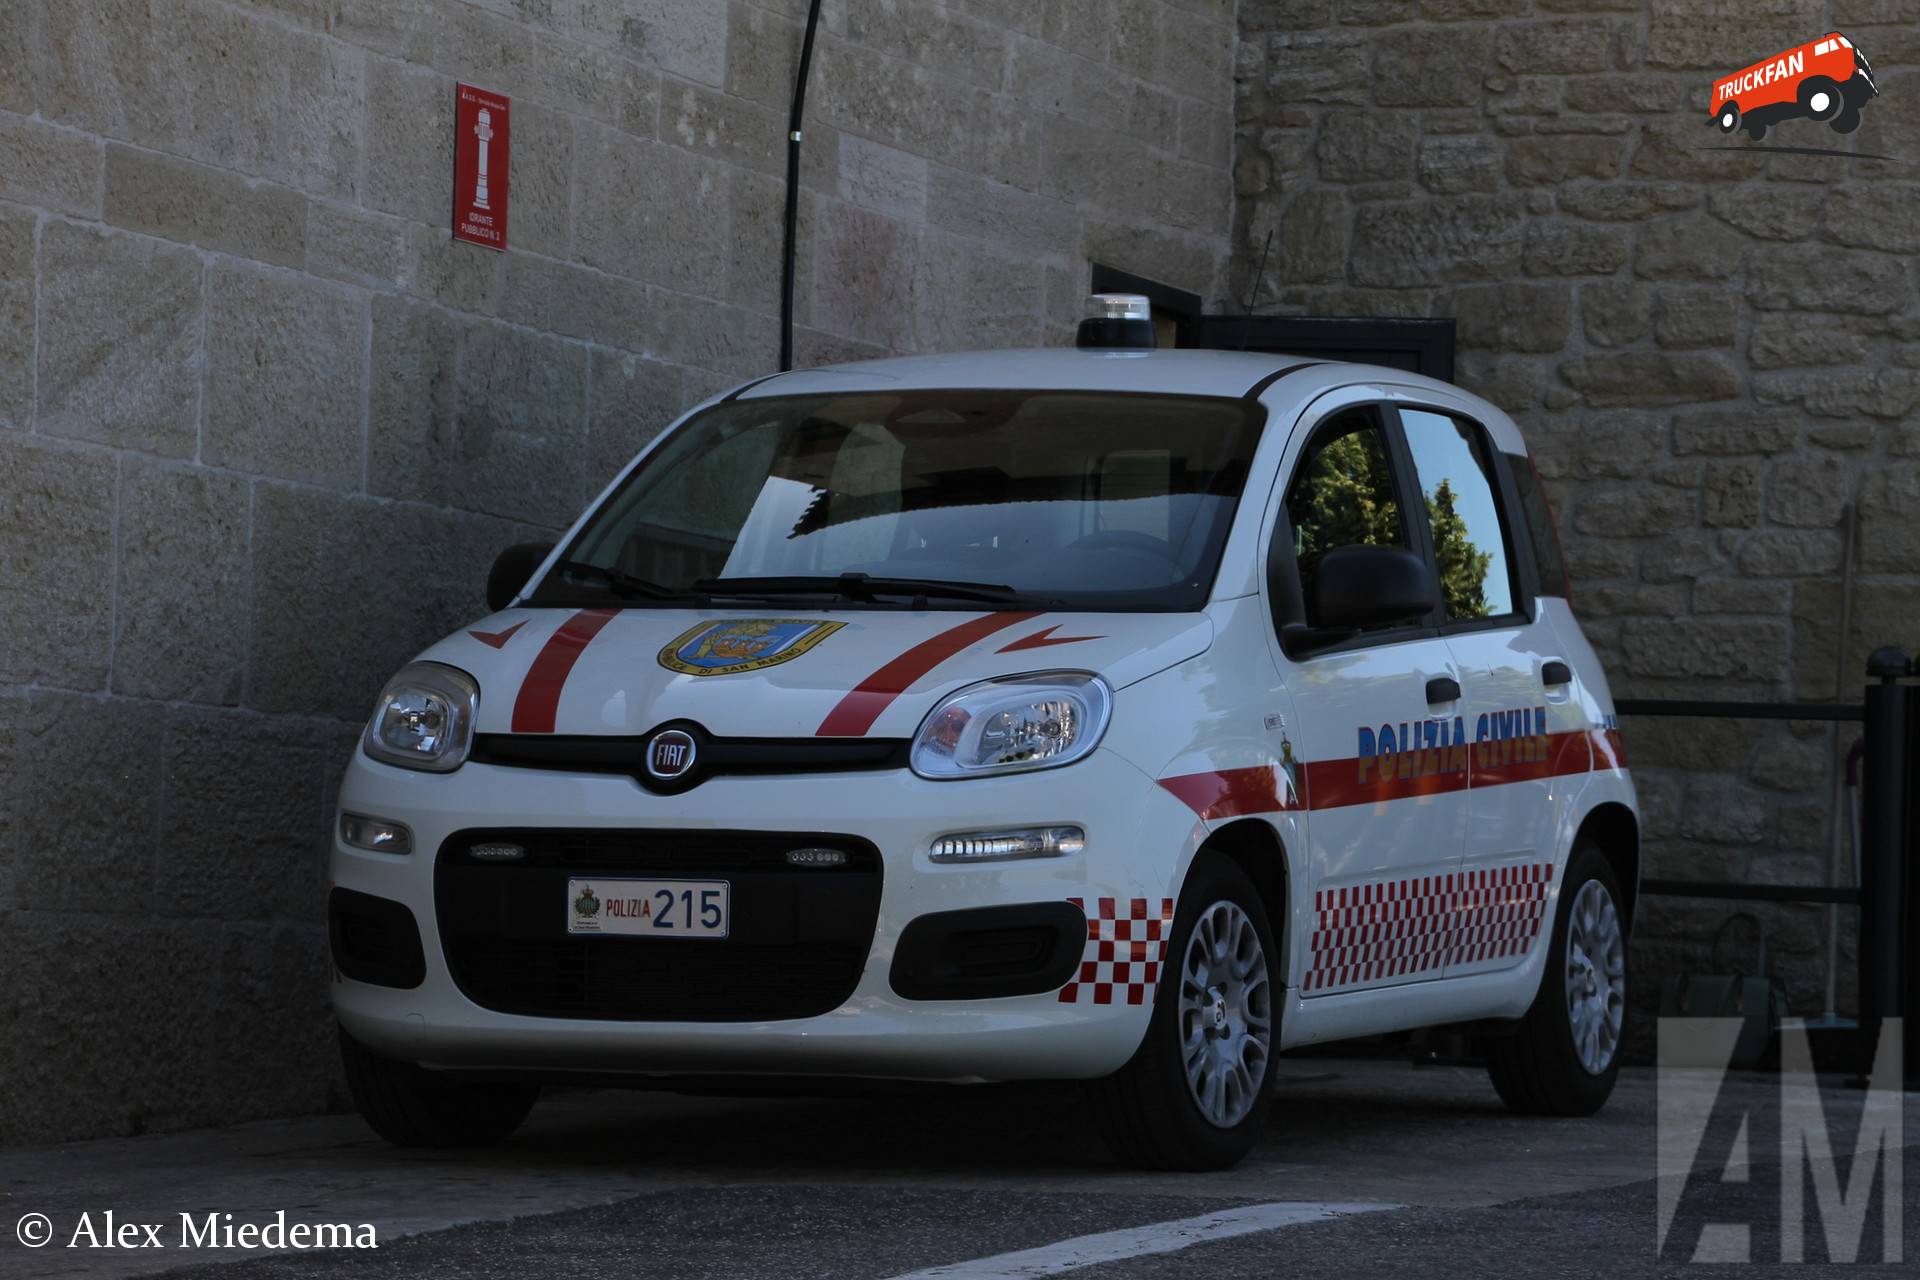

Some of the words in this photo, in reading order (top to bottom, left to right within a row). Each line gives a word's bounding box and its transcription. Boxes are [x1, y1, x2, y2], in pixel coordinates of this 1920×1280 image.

[461, 222, 489, 238] PUBBLICO
[468, 211, 493, 226] IDRANTE
[722, 664, 750, 672] SAN
[757, 648, 803, 667] MARINO
[656, 744, 687, 766] FIAT
[1358, 716, 1468, 785] POLIZIA
[1475, 706, 1549, 769] CIVILE
[606, 898, 651, 917] POLIZIA
[653, 889, 722, 929] 215
